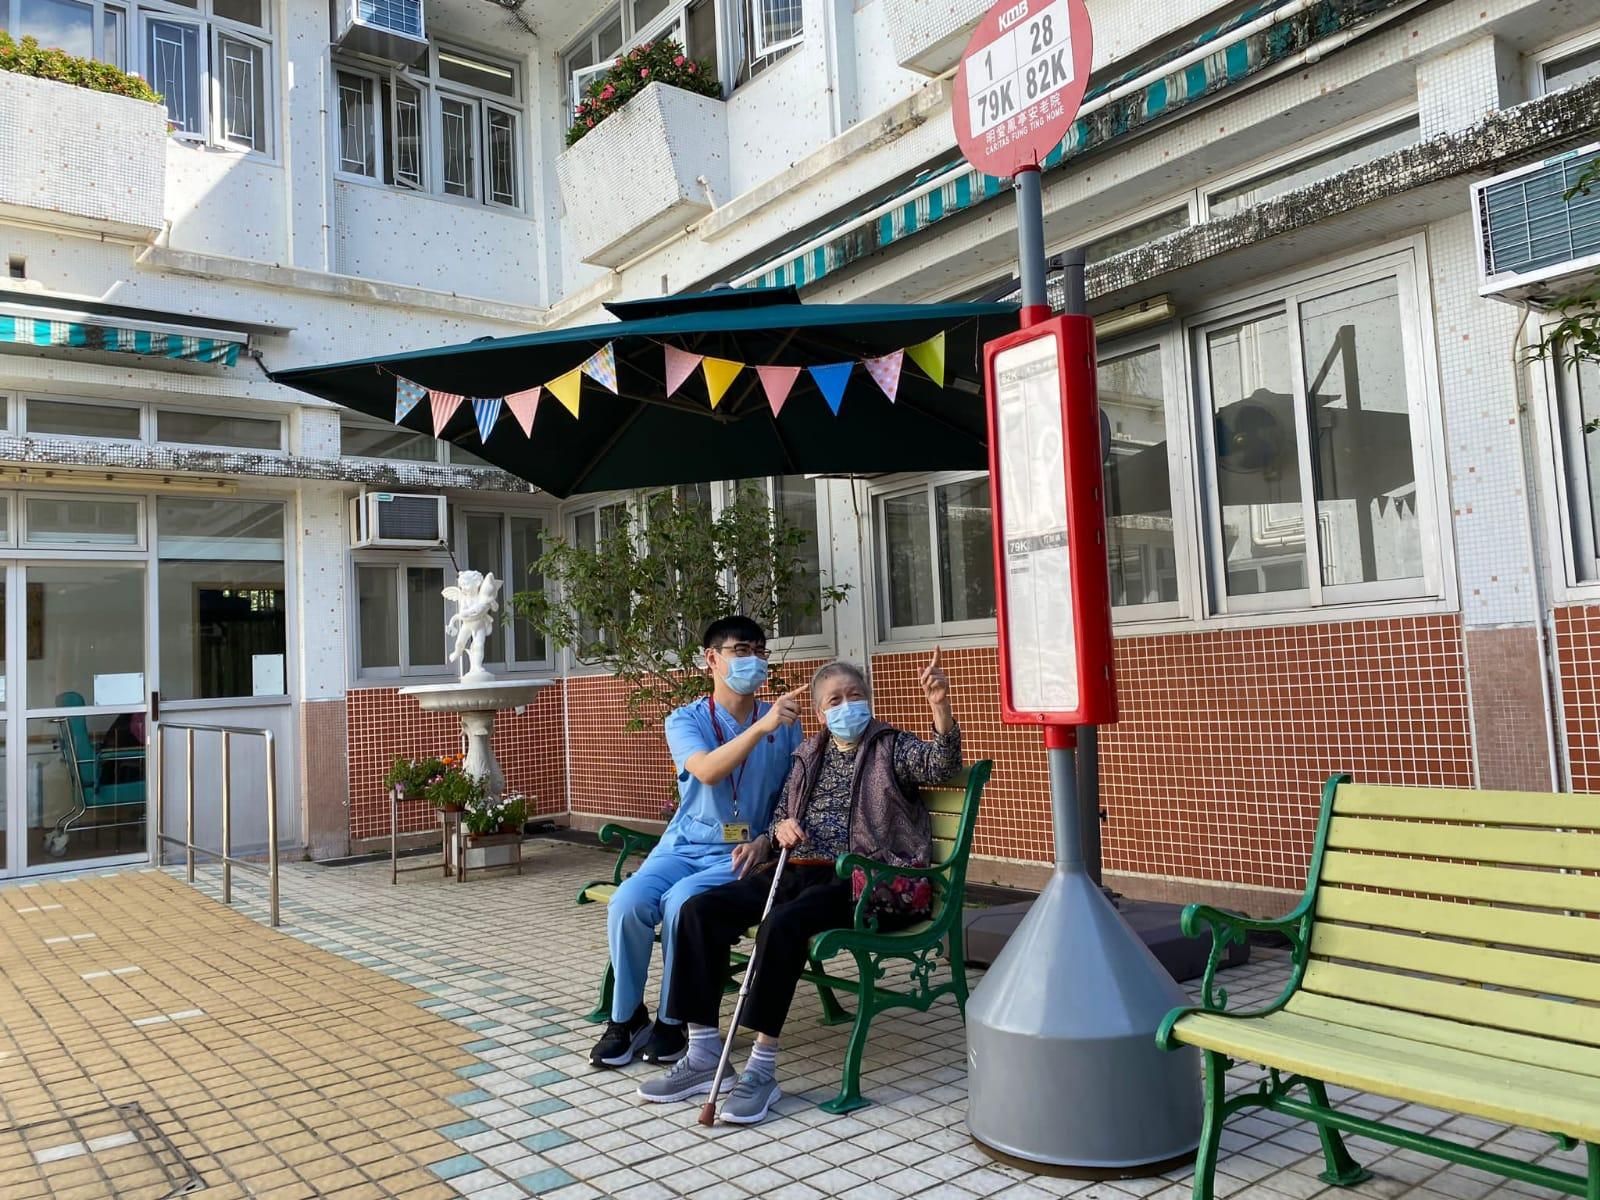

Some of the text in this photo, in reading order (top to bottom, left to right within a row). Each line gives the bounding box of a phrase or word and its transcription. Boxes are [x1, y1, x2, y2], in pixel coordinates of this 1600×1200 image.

[1030, 15, 1054, 55] 28
[985, 51, 993, 80] 1
[1026, 49, 1067, 99] 82K
[978, 80, 1014, 127] 79K
[985, 105, 1064, 156] CARITAS FUNG TING HOME
[1009, 540, 1028, 553] 79K
